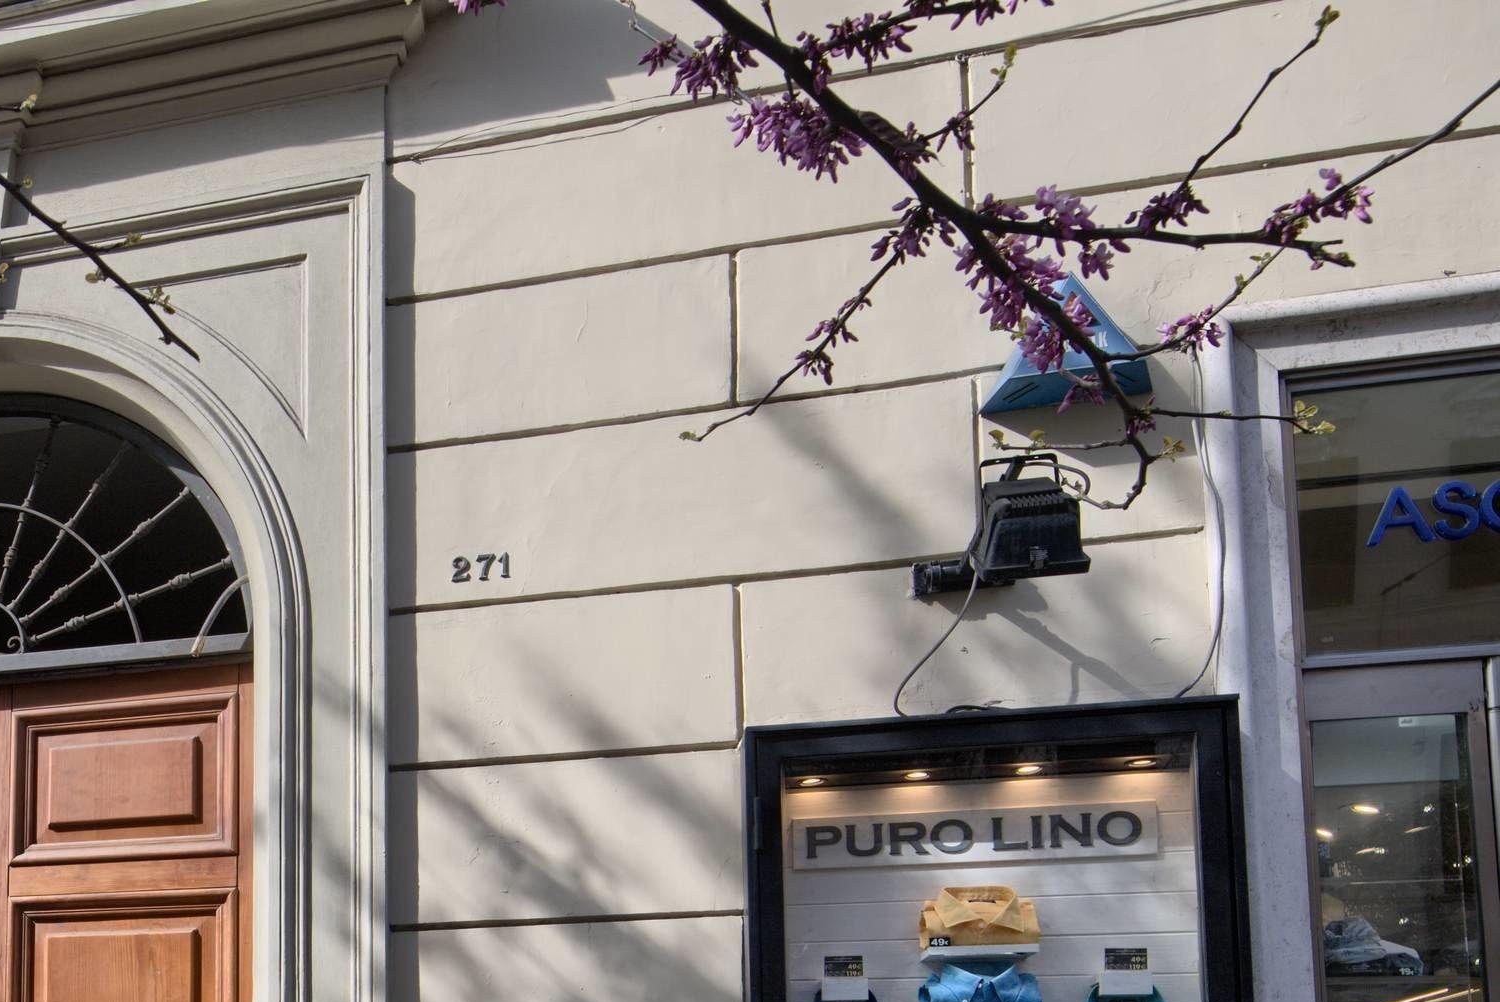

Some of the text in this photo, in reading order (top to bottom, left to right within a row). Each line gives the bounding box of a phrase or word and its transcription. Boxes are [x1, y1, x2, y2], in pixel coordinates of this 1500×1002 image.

[451, 552, 511, 583] 271
[805, 810, 1143, 859] PURO LINO
[931, 938, 949, 946] 49€
